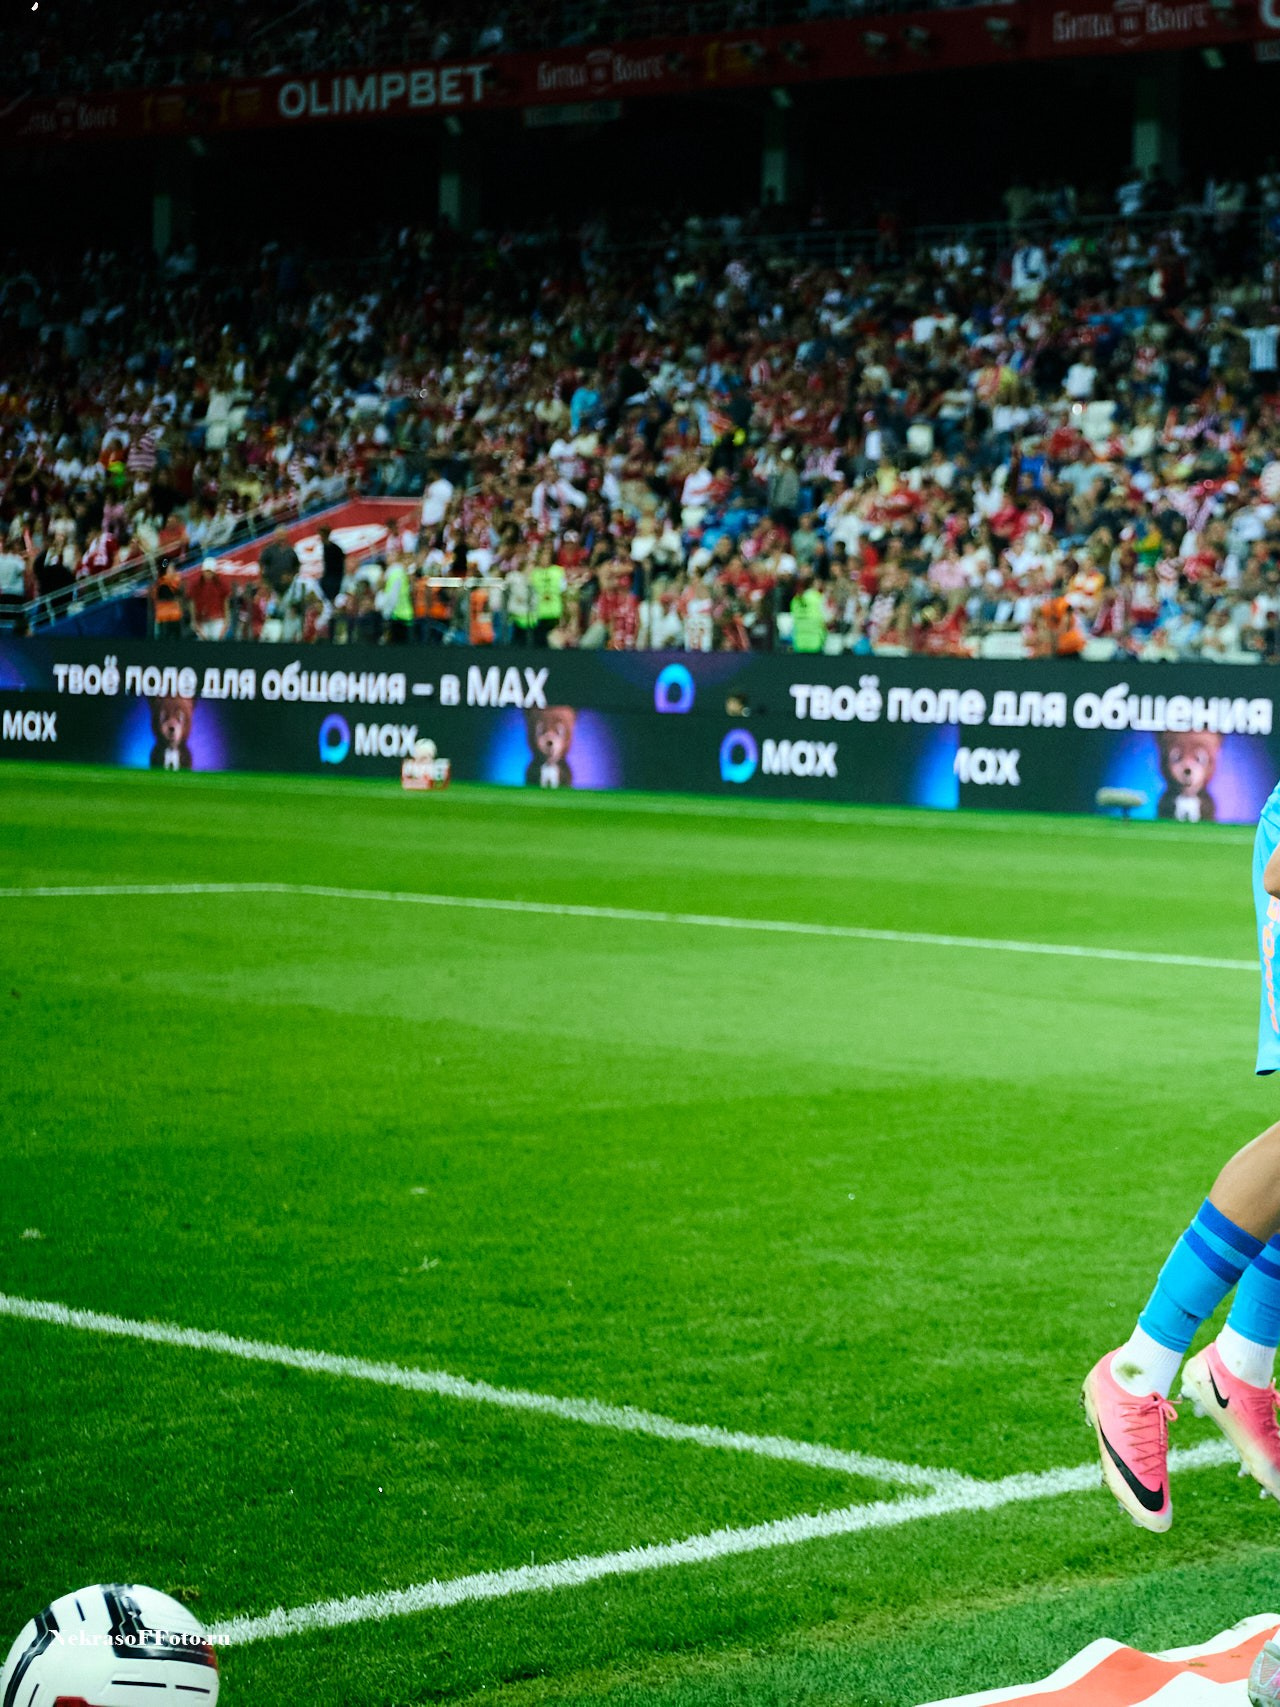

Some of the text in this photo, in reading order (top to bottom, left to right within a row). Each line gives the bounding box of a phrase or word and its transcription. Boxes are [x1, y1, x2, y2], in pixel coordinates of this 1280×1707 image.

[277, 63, 493, 119] OLIMPBET
[53, 655, 120, 696] твоё
[125, 665, 198, 698] поле
[201, 668, 256, 700] для
[262, 660, 406, 705] общения
[439, 674, 460, 706] в
[789, 674, 883, 722] твоё
[887, 687, 986, 725] поле
[988, 690, 1067, 728] для
[1073, 682, 1273, 735] общения
